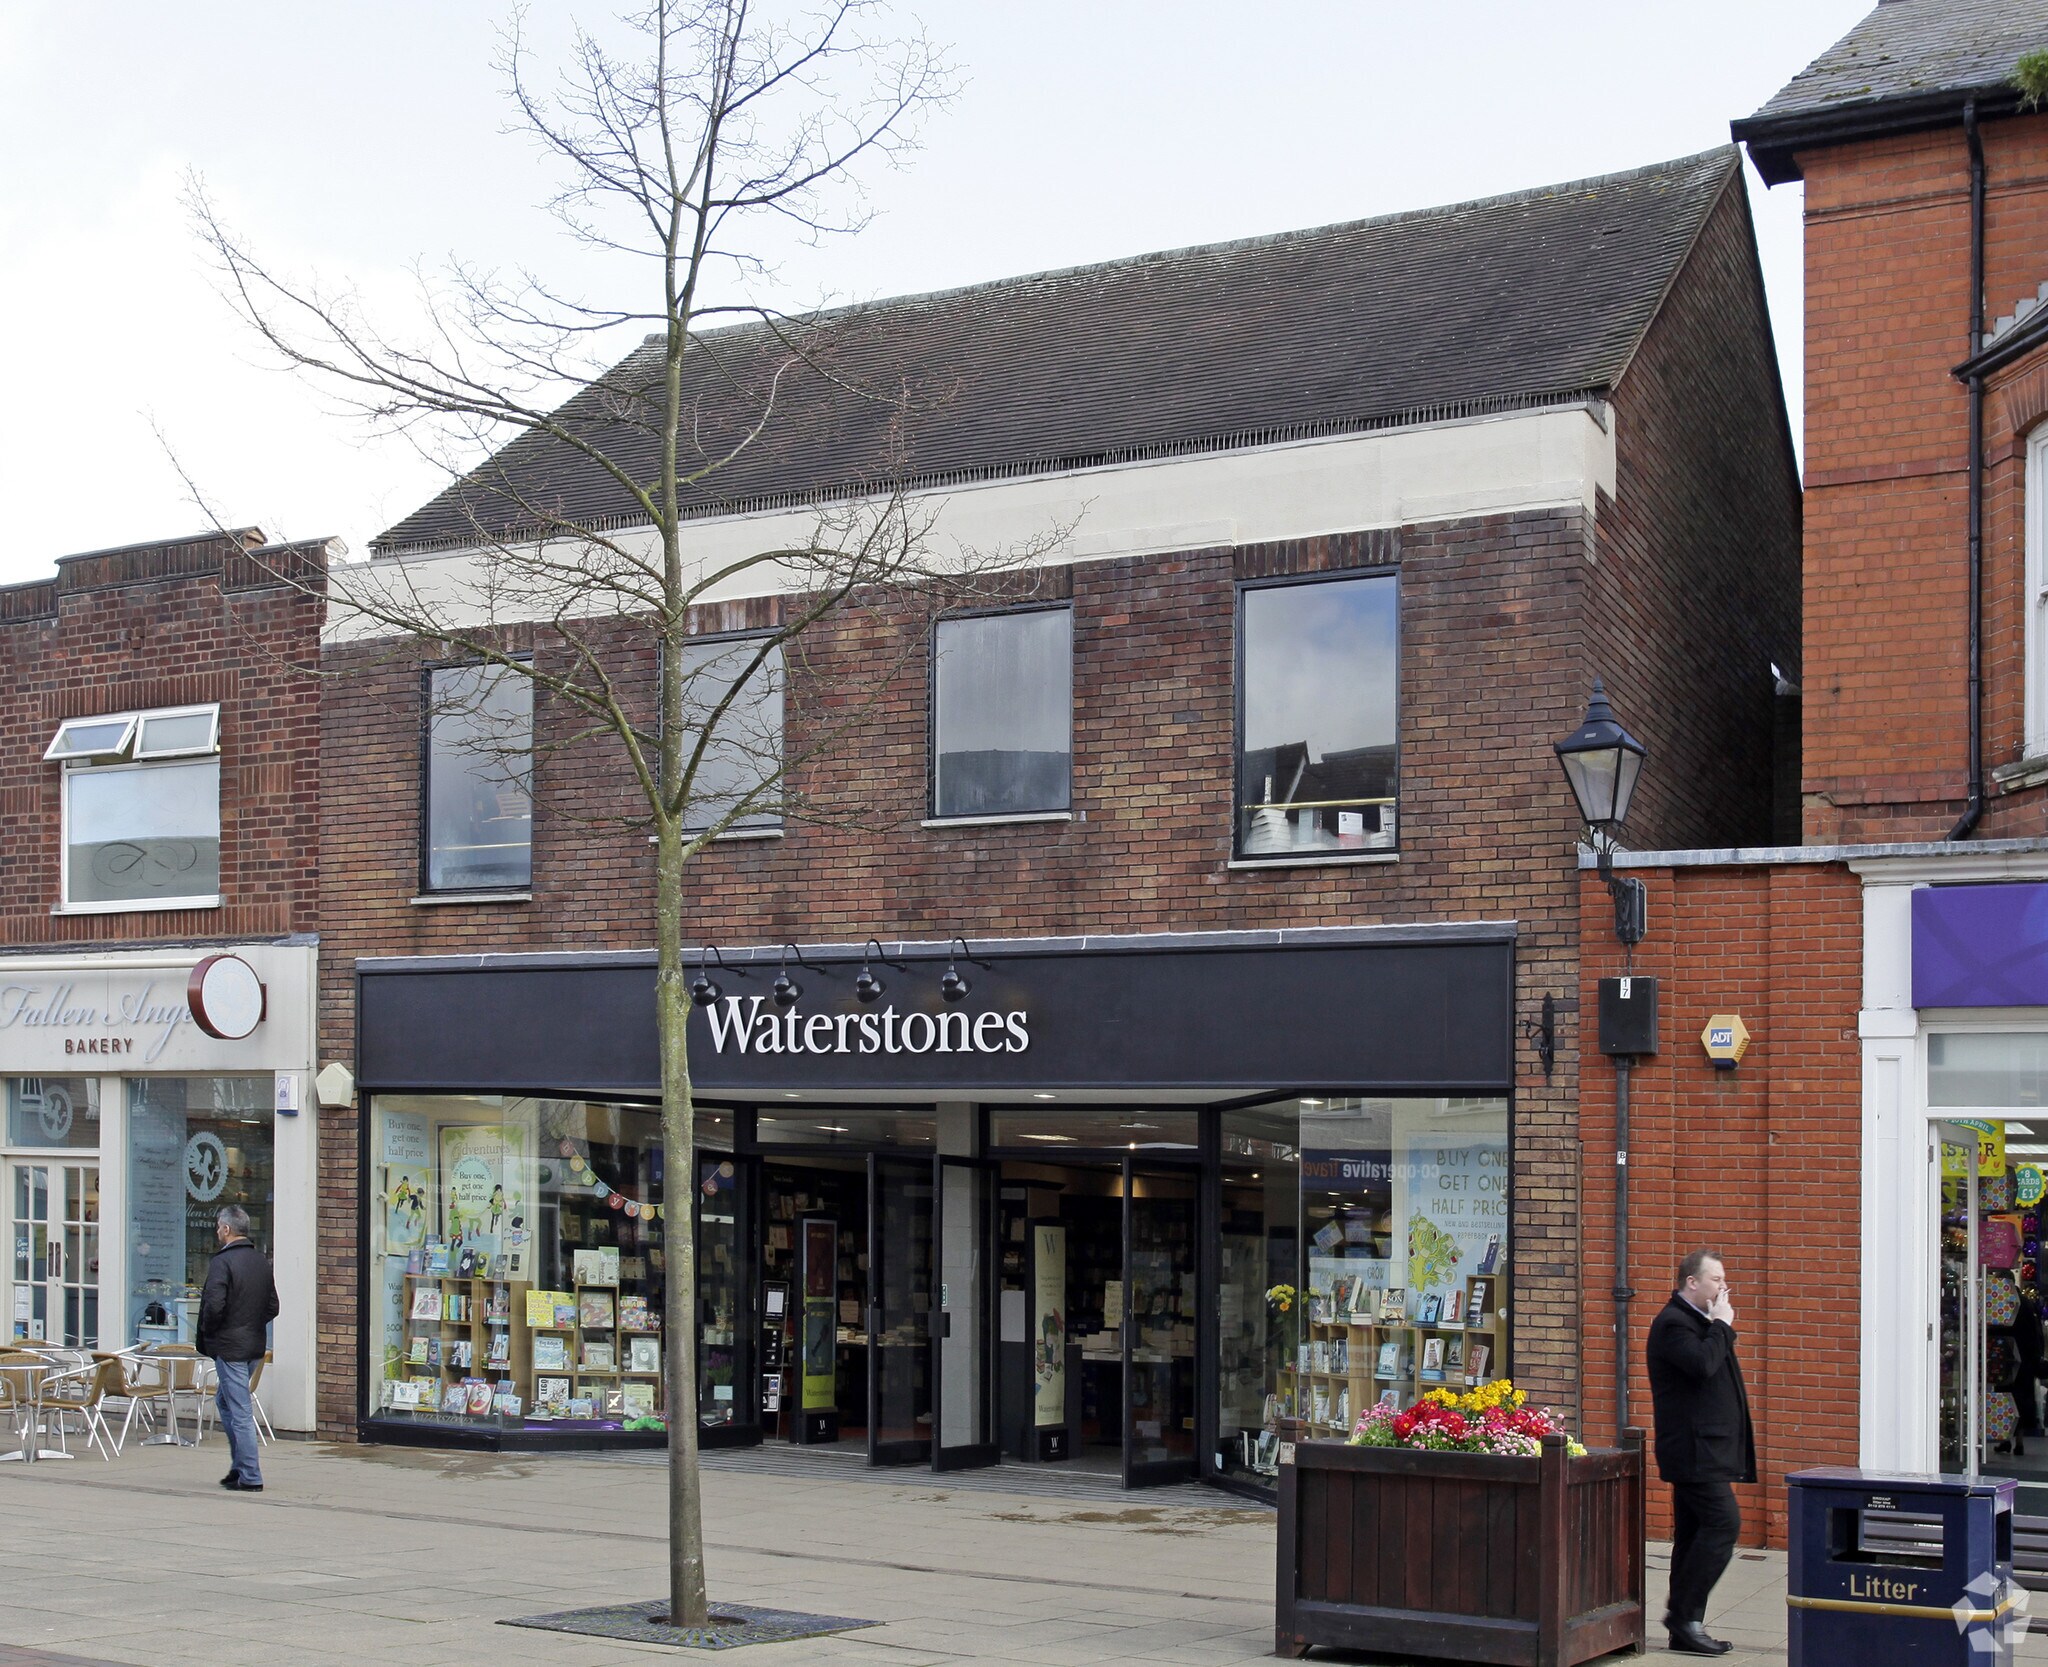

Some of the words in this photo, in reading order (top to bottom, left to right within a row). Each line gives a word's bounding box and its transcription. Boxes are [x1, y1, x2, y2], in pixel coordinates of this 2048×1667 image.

[0, 983, 95, 1029] Fallen
[706, 996, 1030, 1054] Waterstones
[1711, 1032, 1732, 1044] ADT
[65, 1037, 133, 1054] BAKERY
[388, 1119, 405, 1133] Buy
[406, 1123, 422, 1133] one,
[1970, 1119, 1989, 1132] APRIL
[392, 1135, 404, 1144] get
[406, 1136, 420, 1144] one
[388, 1146, 404, 1156] half
[405, 1148, 424, 1159] price
[1436, 1150, 1469, 1167] BUY
[1478, 1150, 1508, 1168] ONE
[459, 1171, 473, 1181] Buy
[2024, 1169, 2031, 1178] 8
[1438, 1174, 1470, 1191] GET
[458, 1192, 471, 1201] half
[471, 1194, 487, 1203] price
[1431, 1199, 1465, 1215] HALF
[190, 1221, 216, 1229] BAKERY
[1367, 1265, 1385, 1280] GROW
[1388, 1295, 1403, 1304] SON
[540, 1379, 549, 1395] LEGO
[1051, 1437, 1059, 1448] W
[1849, 1573, 1918, 1601] Litter
